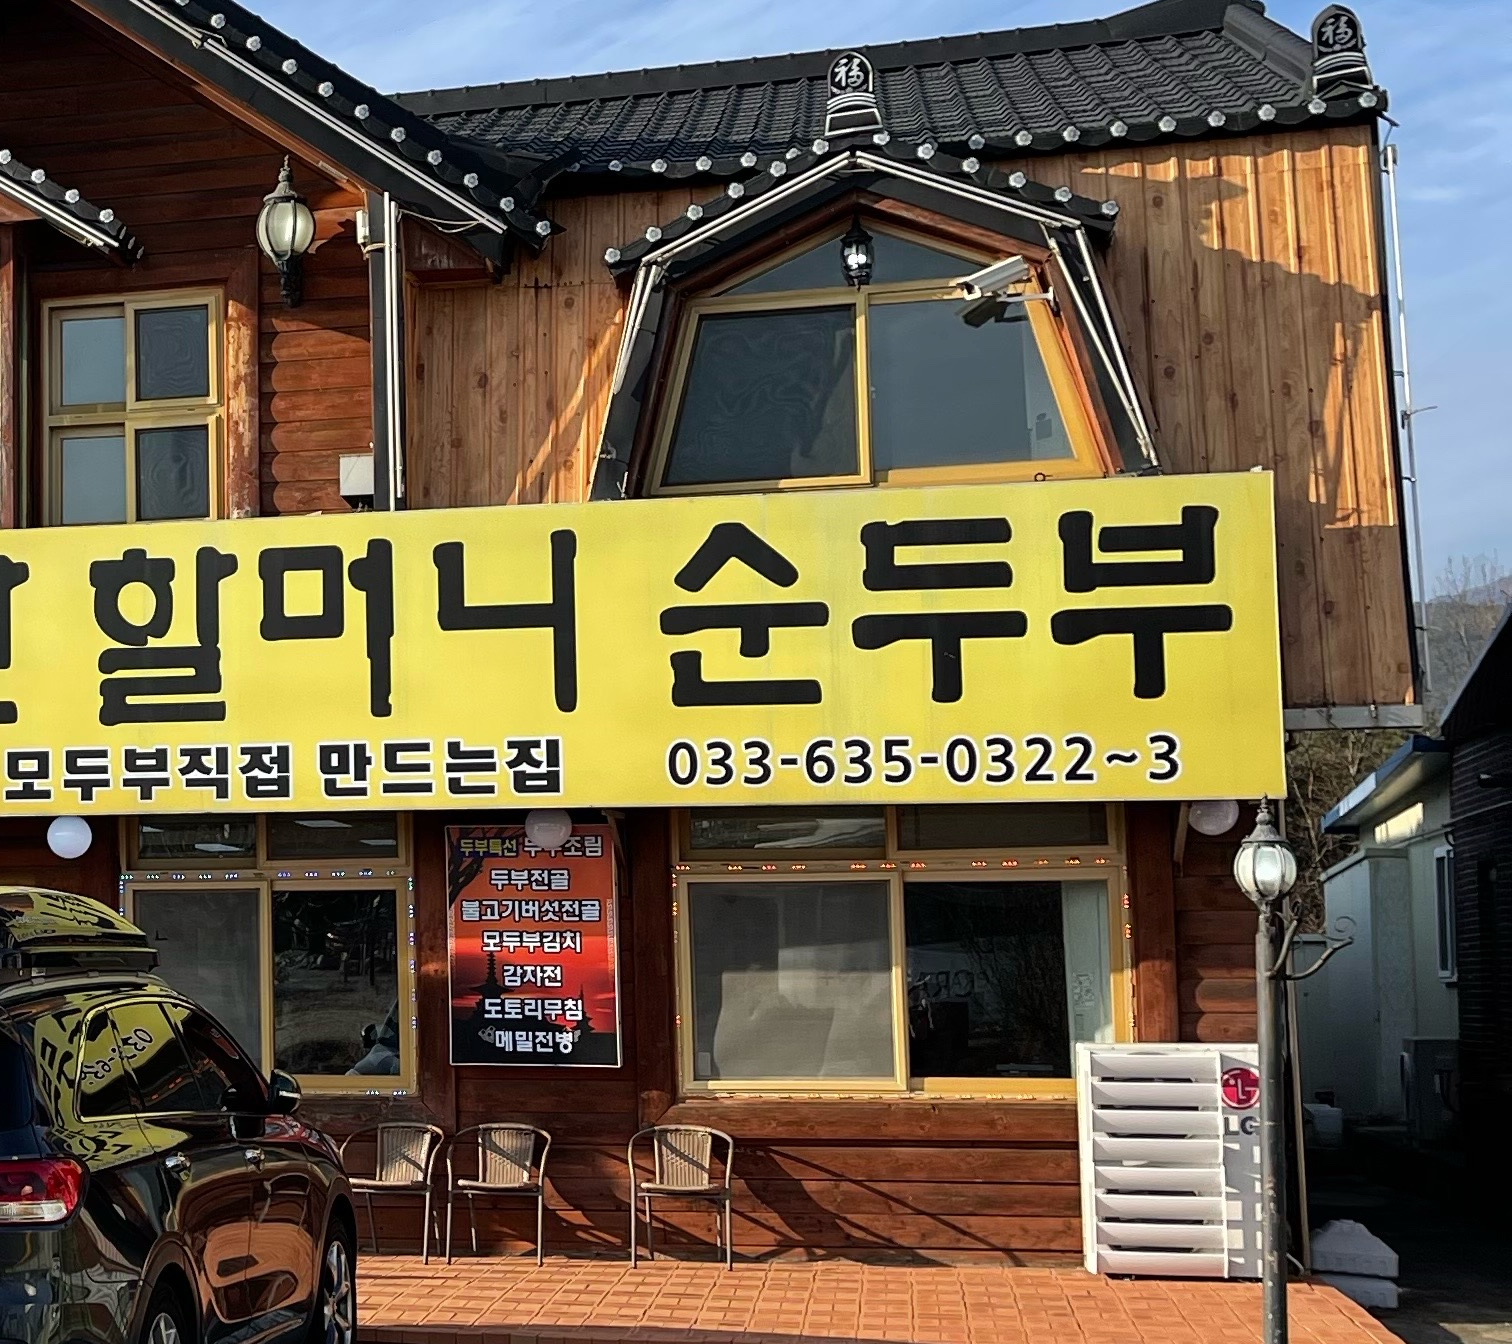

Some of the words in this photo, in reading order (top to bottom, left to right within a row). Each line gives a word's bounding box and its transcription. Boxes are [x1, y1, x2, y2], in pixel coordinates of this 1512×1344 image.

[1321, 17, 1354, 45] 福
[834, 56, 863, 86] 福
[89, 529, 578, 726] 할머니
[660, 505, 1233, 707] 순두부
[5, 743, 291, 803] 모두부직접
[319, 737, 563, 801] 만드는집
[667, 733, 1182, 788] 033-635-0322~3
[459, 837, 518, 854] 두부특선
[490, 869, 569, 891] 두부전골
[461, 899, 601, 922] 불고기버섯전골
[482, 931, 582, 953] 모두부김치
[503, 965, 562, 987] 감자전
[484, 998, 583, 1021] 도토리무침
[495, 1030, 575, 1054] 메밀전병
[1224, 1116, 1261, 1136] LG
